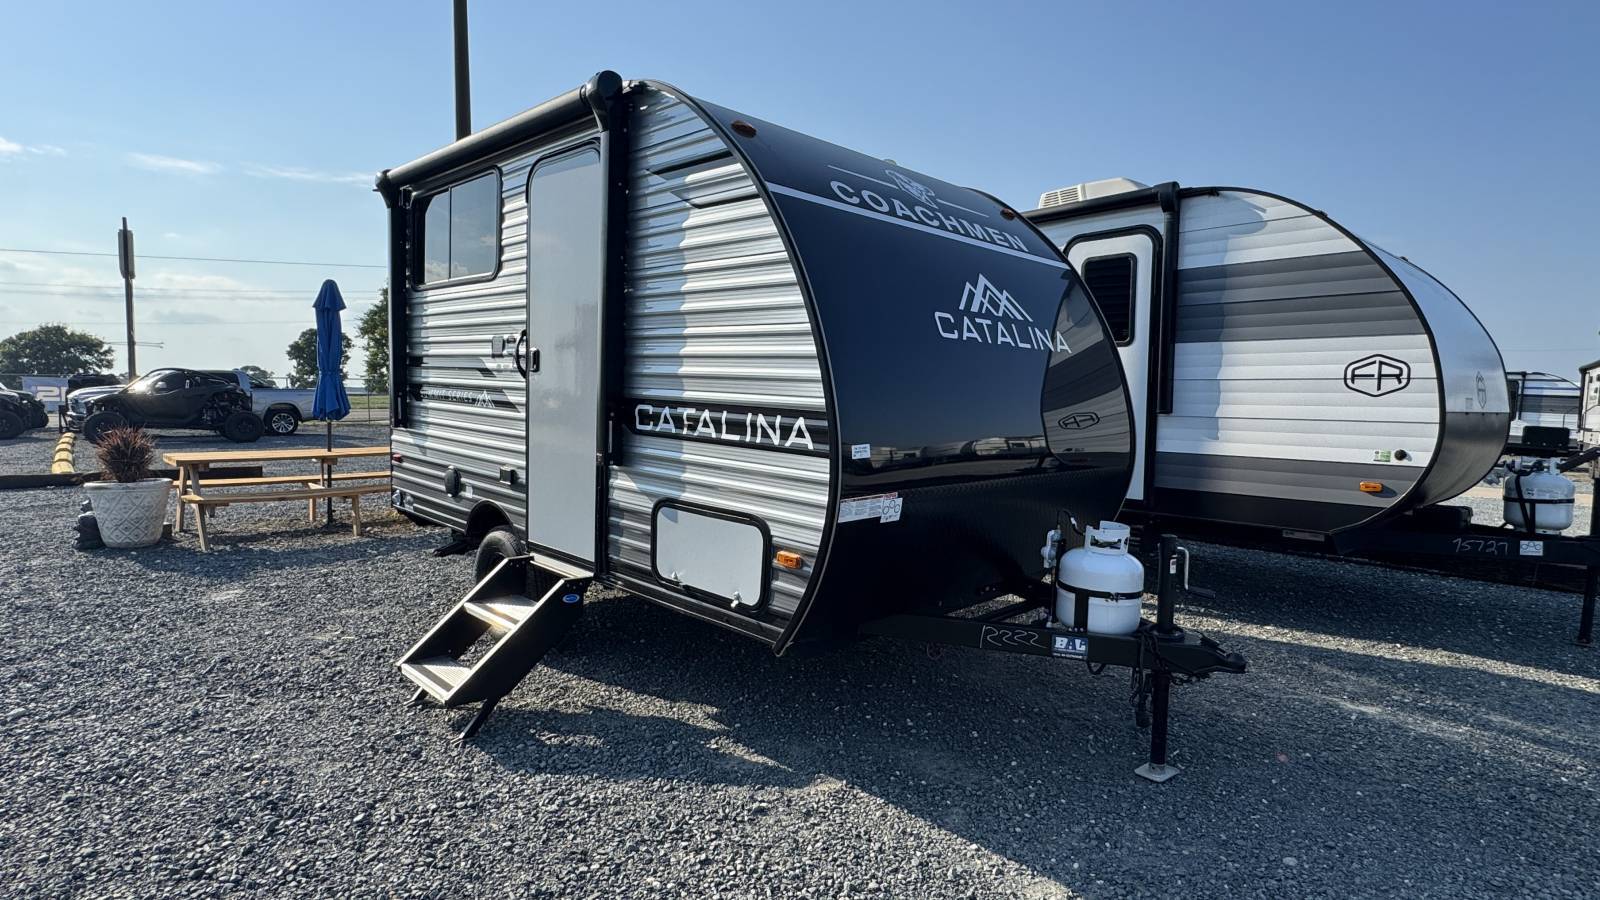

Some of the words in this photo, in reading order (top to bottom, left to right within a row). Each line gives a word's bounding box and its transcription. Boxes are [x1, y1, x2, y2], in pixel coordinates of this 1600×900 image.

[830, 180, 1028, 252] COACHMEN
[934, 311, 1072, 354] CATALINA
[634, 404, 815, 450] CATALINA
